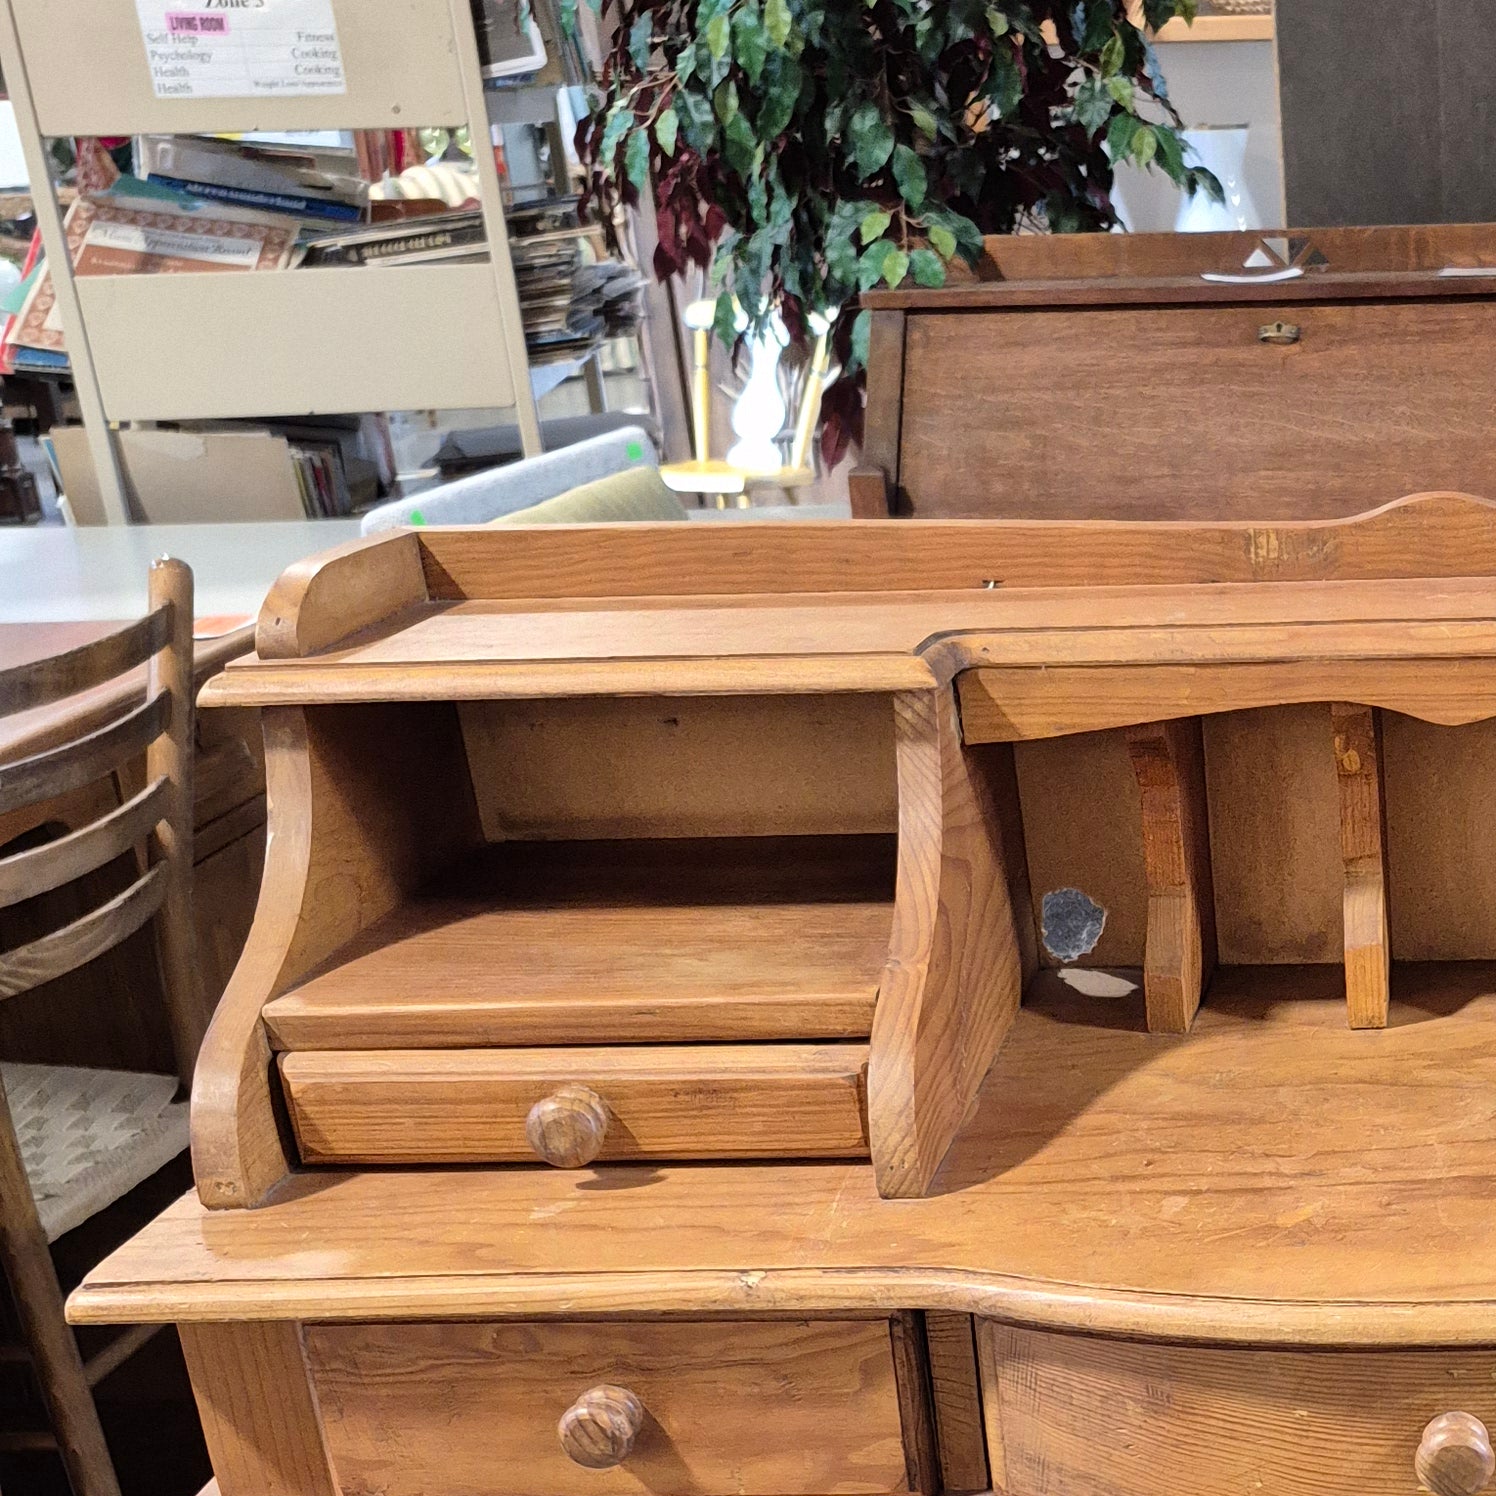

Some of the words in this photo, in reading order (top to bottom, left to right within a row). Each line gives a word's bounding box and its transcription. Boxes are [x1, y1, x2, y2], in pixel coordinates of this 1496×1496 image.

[169, 16, 198, 31] LIVING
[199, 17, 225, 31] ROOM
[146, 33, 169, 44] Self
[171, 33, 199, 47] Help
[150, 49, 213, 63] Psychology
[291, 47, 339, 61] Cooking
[154, 65, 190, 77] Health
[294, 63, 341, 78] Cooking
[157, 82, 193, 95] Health
